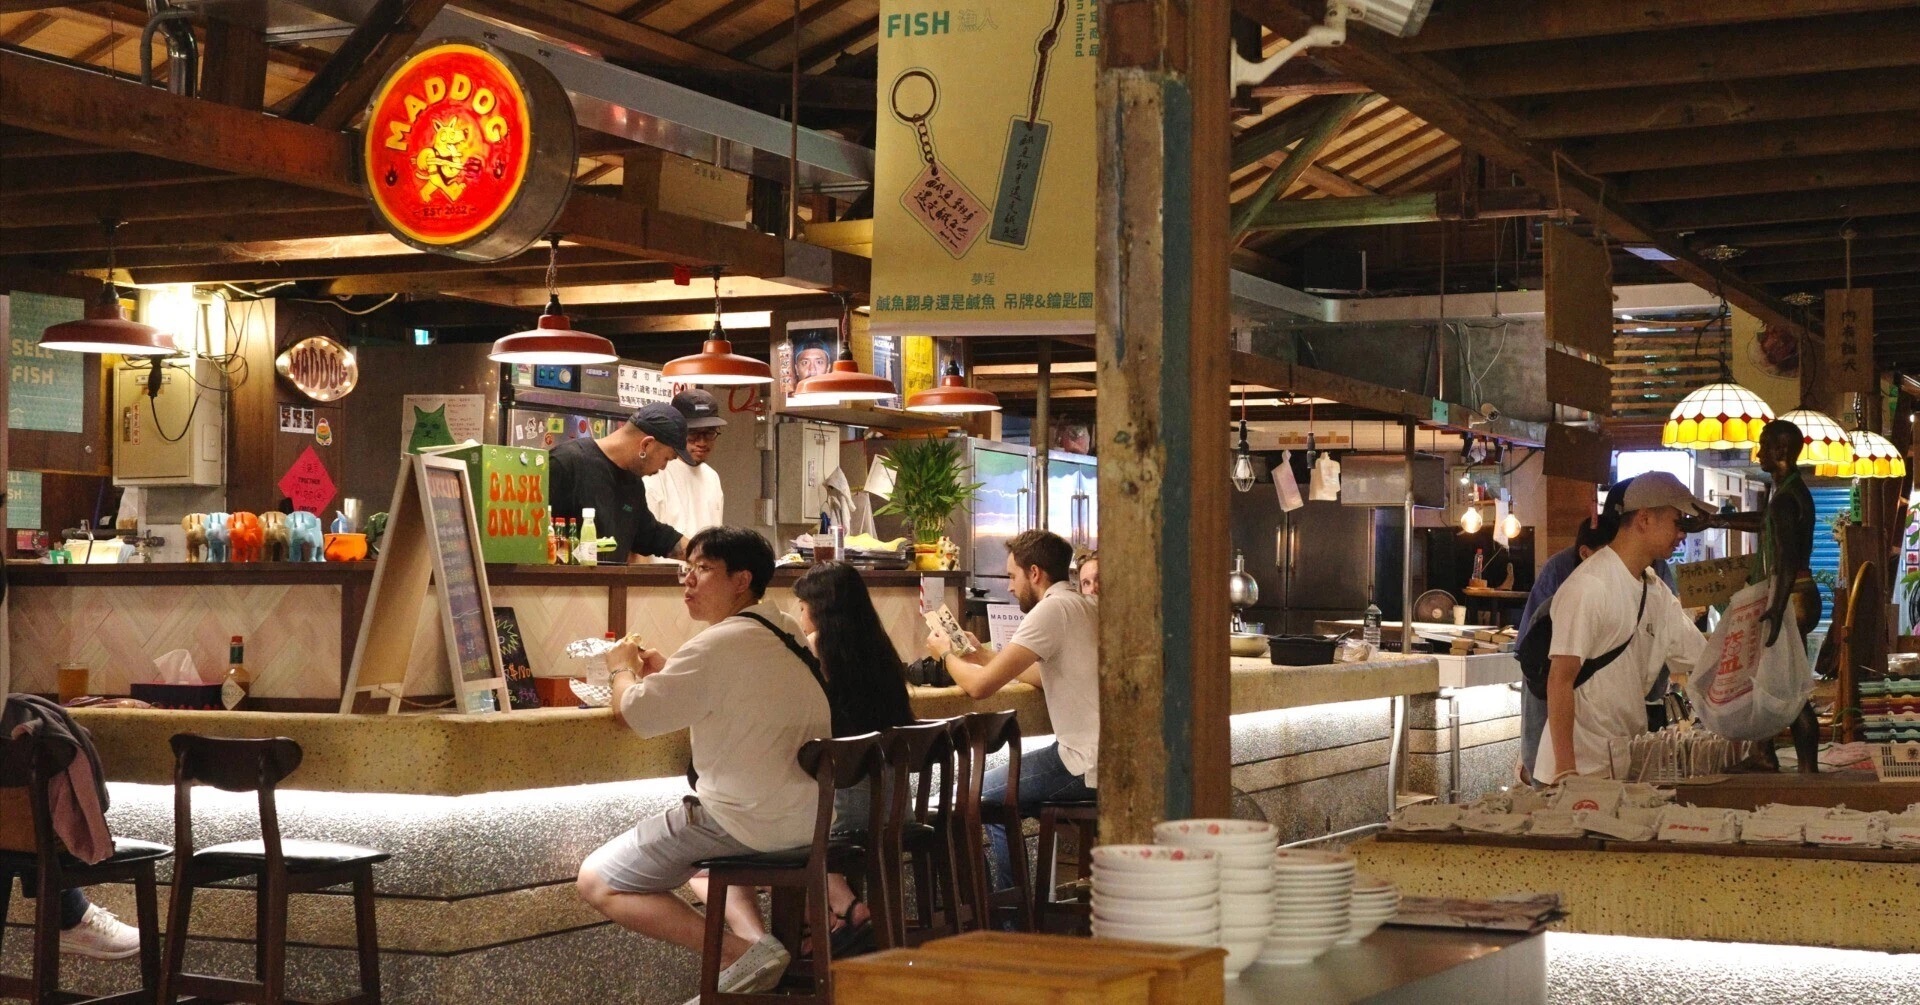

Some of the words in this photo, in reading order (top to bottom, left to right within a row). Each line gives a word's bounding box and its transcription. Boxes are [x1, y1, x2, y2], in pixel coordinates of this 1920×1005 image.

[887, 11, 950, 38] FISH
[957, 8, 998, 32] 漁人
[1075, 13, 1085, 57] limited
[385, 73, 508, 151] MADDOG
[423, 207, 442, 217] EST
[875, 293, 996, 312] 鹹魚翻身還是鹹魚
[1003, 292, 1094, 310] 吊牌&鑰匙圈
[11, 338, 54, 359] SELL
[12, 366, 54, 385] FISH
[290, 346, 348, 390] MADDOG
[489, 472, 543, 503] CASH
[487, 508, 546, 537] ONLY
